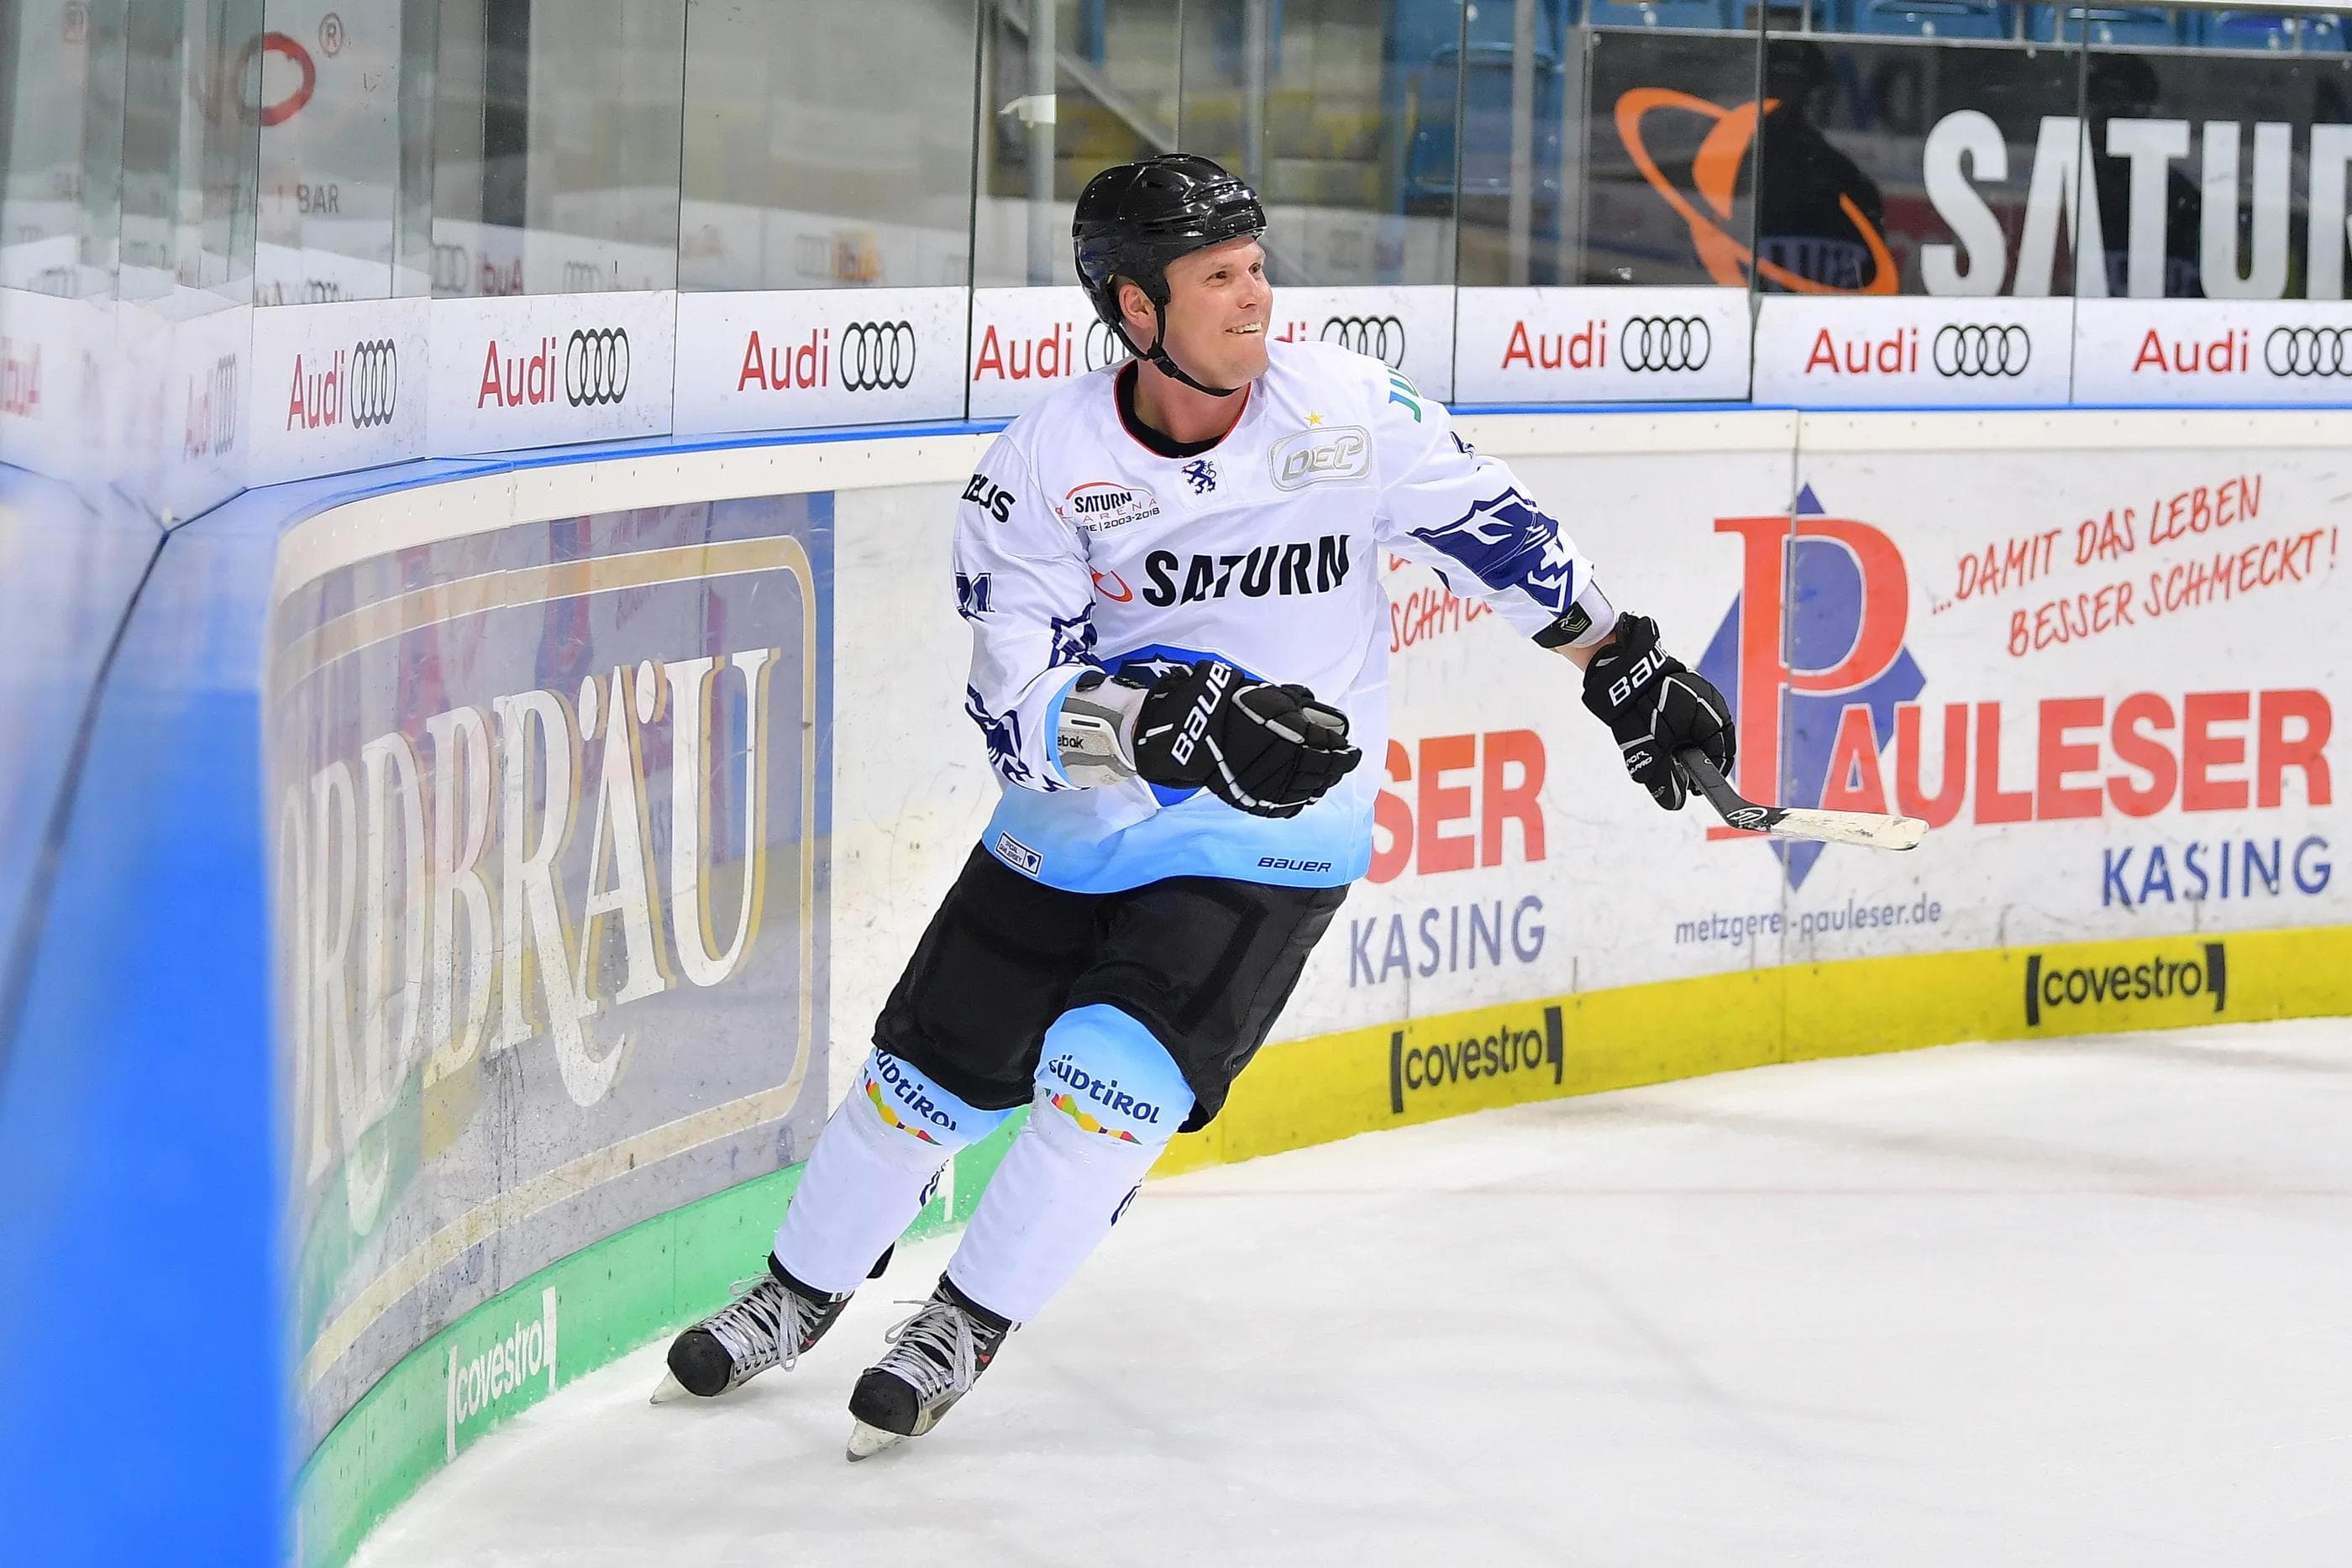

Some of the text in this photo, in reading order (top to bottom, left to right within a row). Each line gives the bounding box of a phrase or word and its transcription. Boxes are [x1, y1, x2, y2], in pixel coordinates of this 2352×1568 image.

[476, 339, 556, 409] Audi
[738, 329, 829, 391] Audi
[974, 323, 1072, 381] Audi
[1502, 322, 1606, 370] Audi
[1806, 328, 1919, 375] Audi
[2133, 330, 2250, 373] Audi
[286, 349, 345, 432] Audi
[1074, 492, 1132, 512] SATURN
[1084, 498, 1157, 522] ARENA
[1103, 506, 1161, 530] 2003-2018
[2075, 507, 2136, 566] DAS
[2150, 474, 2262, 545] LEBEN
[1142, 534, 1352, 607] SATURN
[2007, 579, 2135, 659] BESSER
[1257, 857, 1332, 873] BAUER
[2103, 834, 2333, 906] KASING
[1348, 894, 1546, 989] KASING
[1675, 892, 1942, 947] metzgere-pauleser.de
[2043, 957, 2202, 1008] covestro
[1406, 1024, 1543, 1091] covestro
[455, 1319, 544, 1424] covestro
